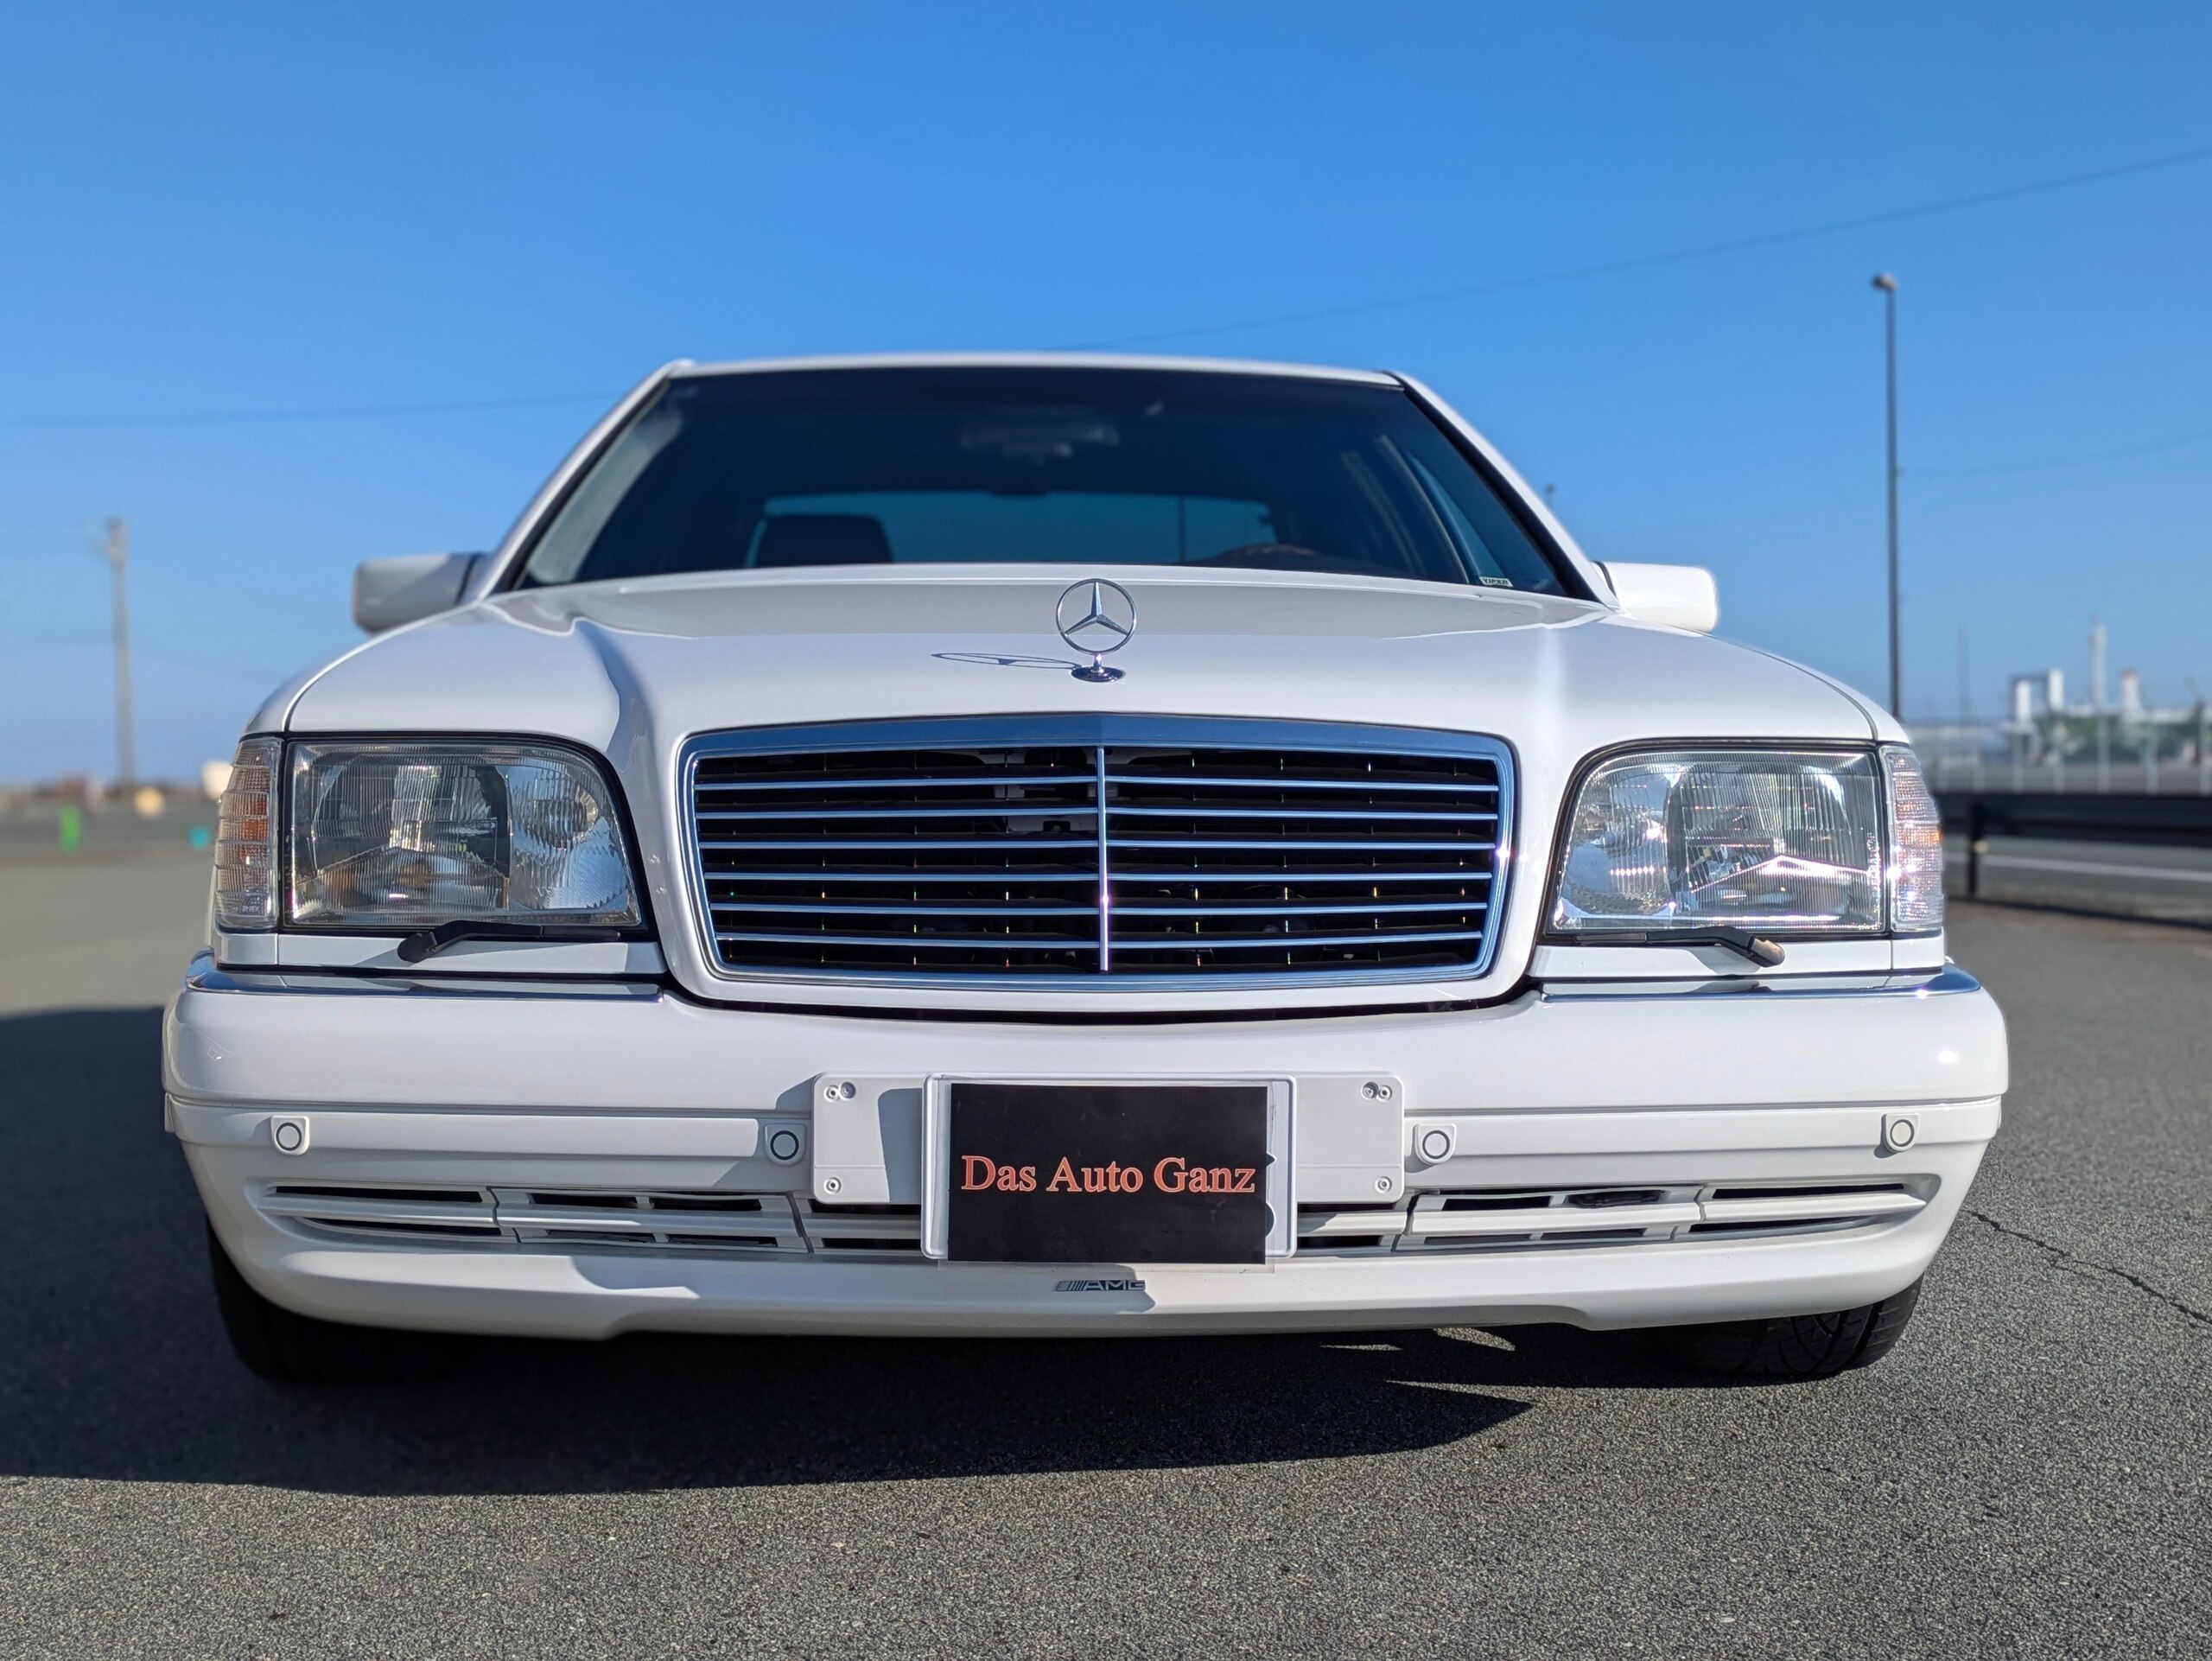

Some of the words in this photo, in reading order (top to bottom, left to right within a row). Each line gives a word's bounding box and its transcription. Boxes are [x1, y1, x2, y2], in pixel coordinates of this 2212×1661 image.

[961, 1155, 1037, 1192] Das
[1046, 1156, 1144, 1193] Auto
[1154, 1156, 1256, 1193] Ganz
[1082, 1280, 1146, 1291] AMG
